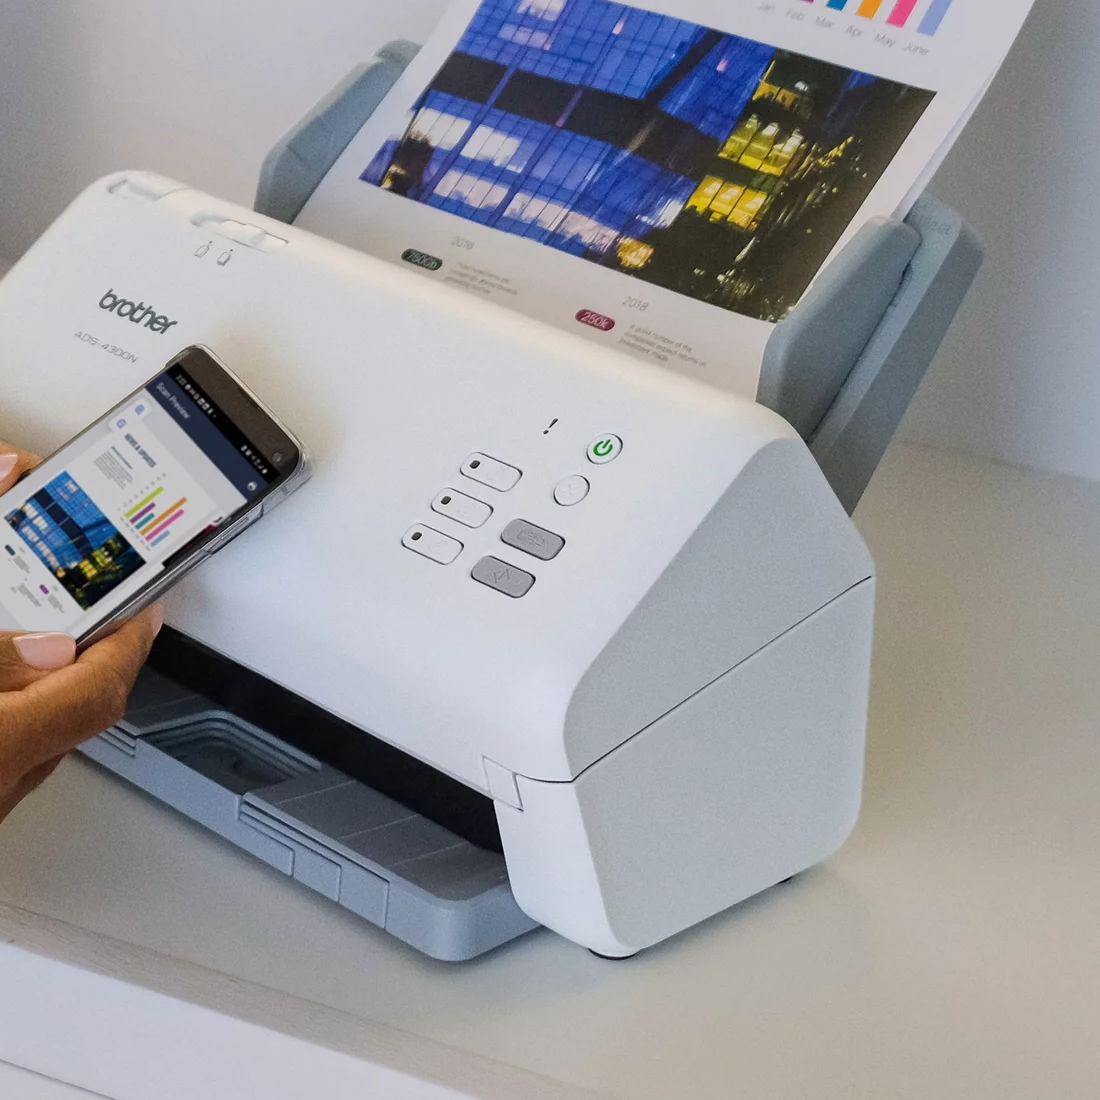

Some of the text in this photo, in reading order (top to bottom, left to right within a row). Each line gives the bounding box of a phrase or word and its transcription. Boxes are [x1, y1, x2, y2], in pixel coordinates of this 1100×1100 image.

[757, 2, 929, 56] Jan Feb Mar Apr May June
[99, 288, 178, 335] brother
[581, 311, 609, 328] 250k
[622, 296, 649, 312] 2018
[74, 330, 138, 364] ADS-4300N
[156, 382, 190, 419] Scan Preview
